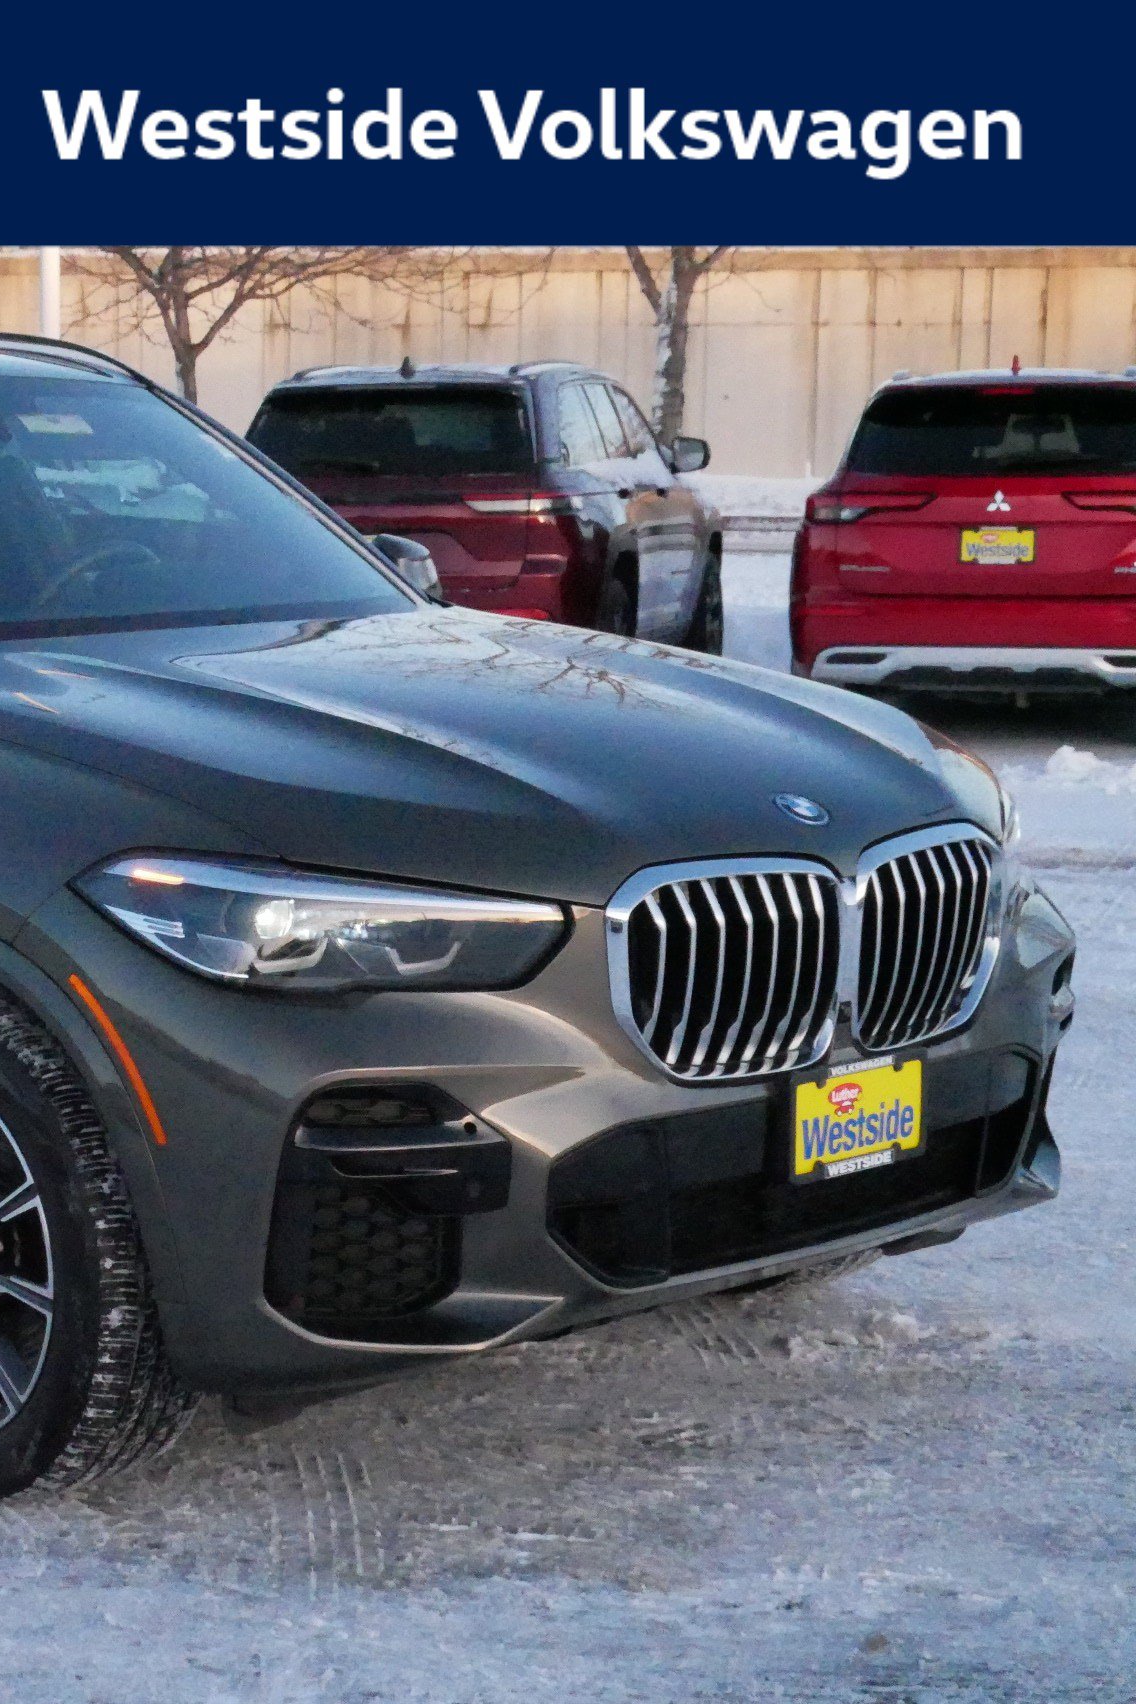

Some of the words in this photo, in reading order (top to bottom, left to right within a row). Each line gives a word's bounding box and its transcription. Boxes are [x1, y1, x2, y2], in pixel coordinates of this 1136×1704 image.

[966, 542, 1029, 558] Westside
[831, 1055, 893, 1076] VOLKSWAGEN
[831, 1087, 859, 1103] Luther
[802, 1099, 914, 1160] Westside
[827, 1151, 892, 1177] WESTSIDE
